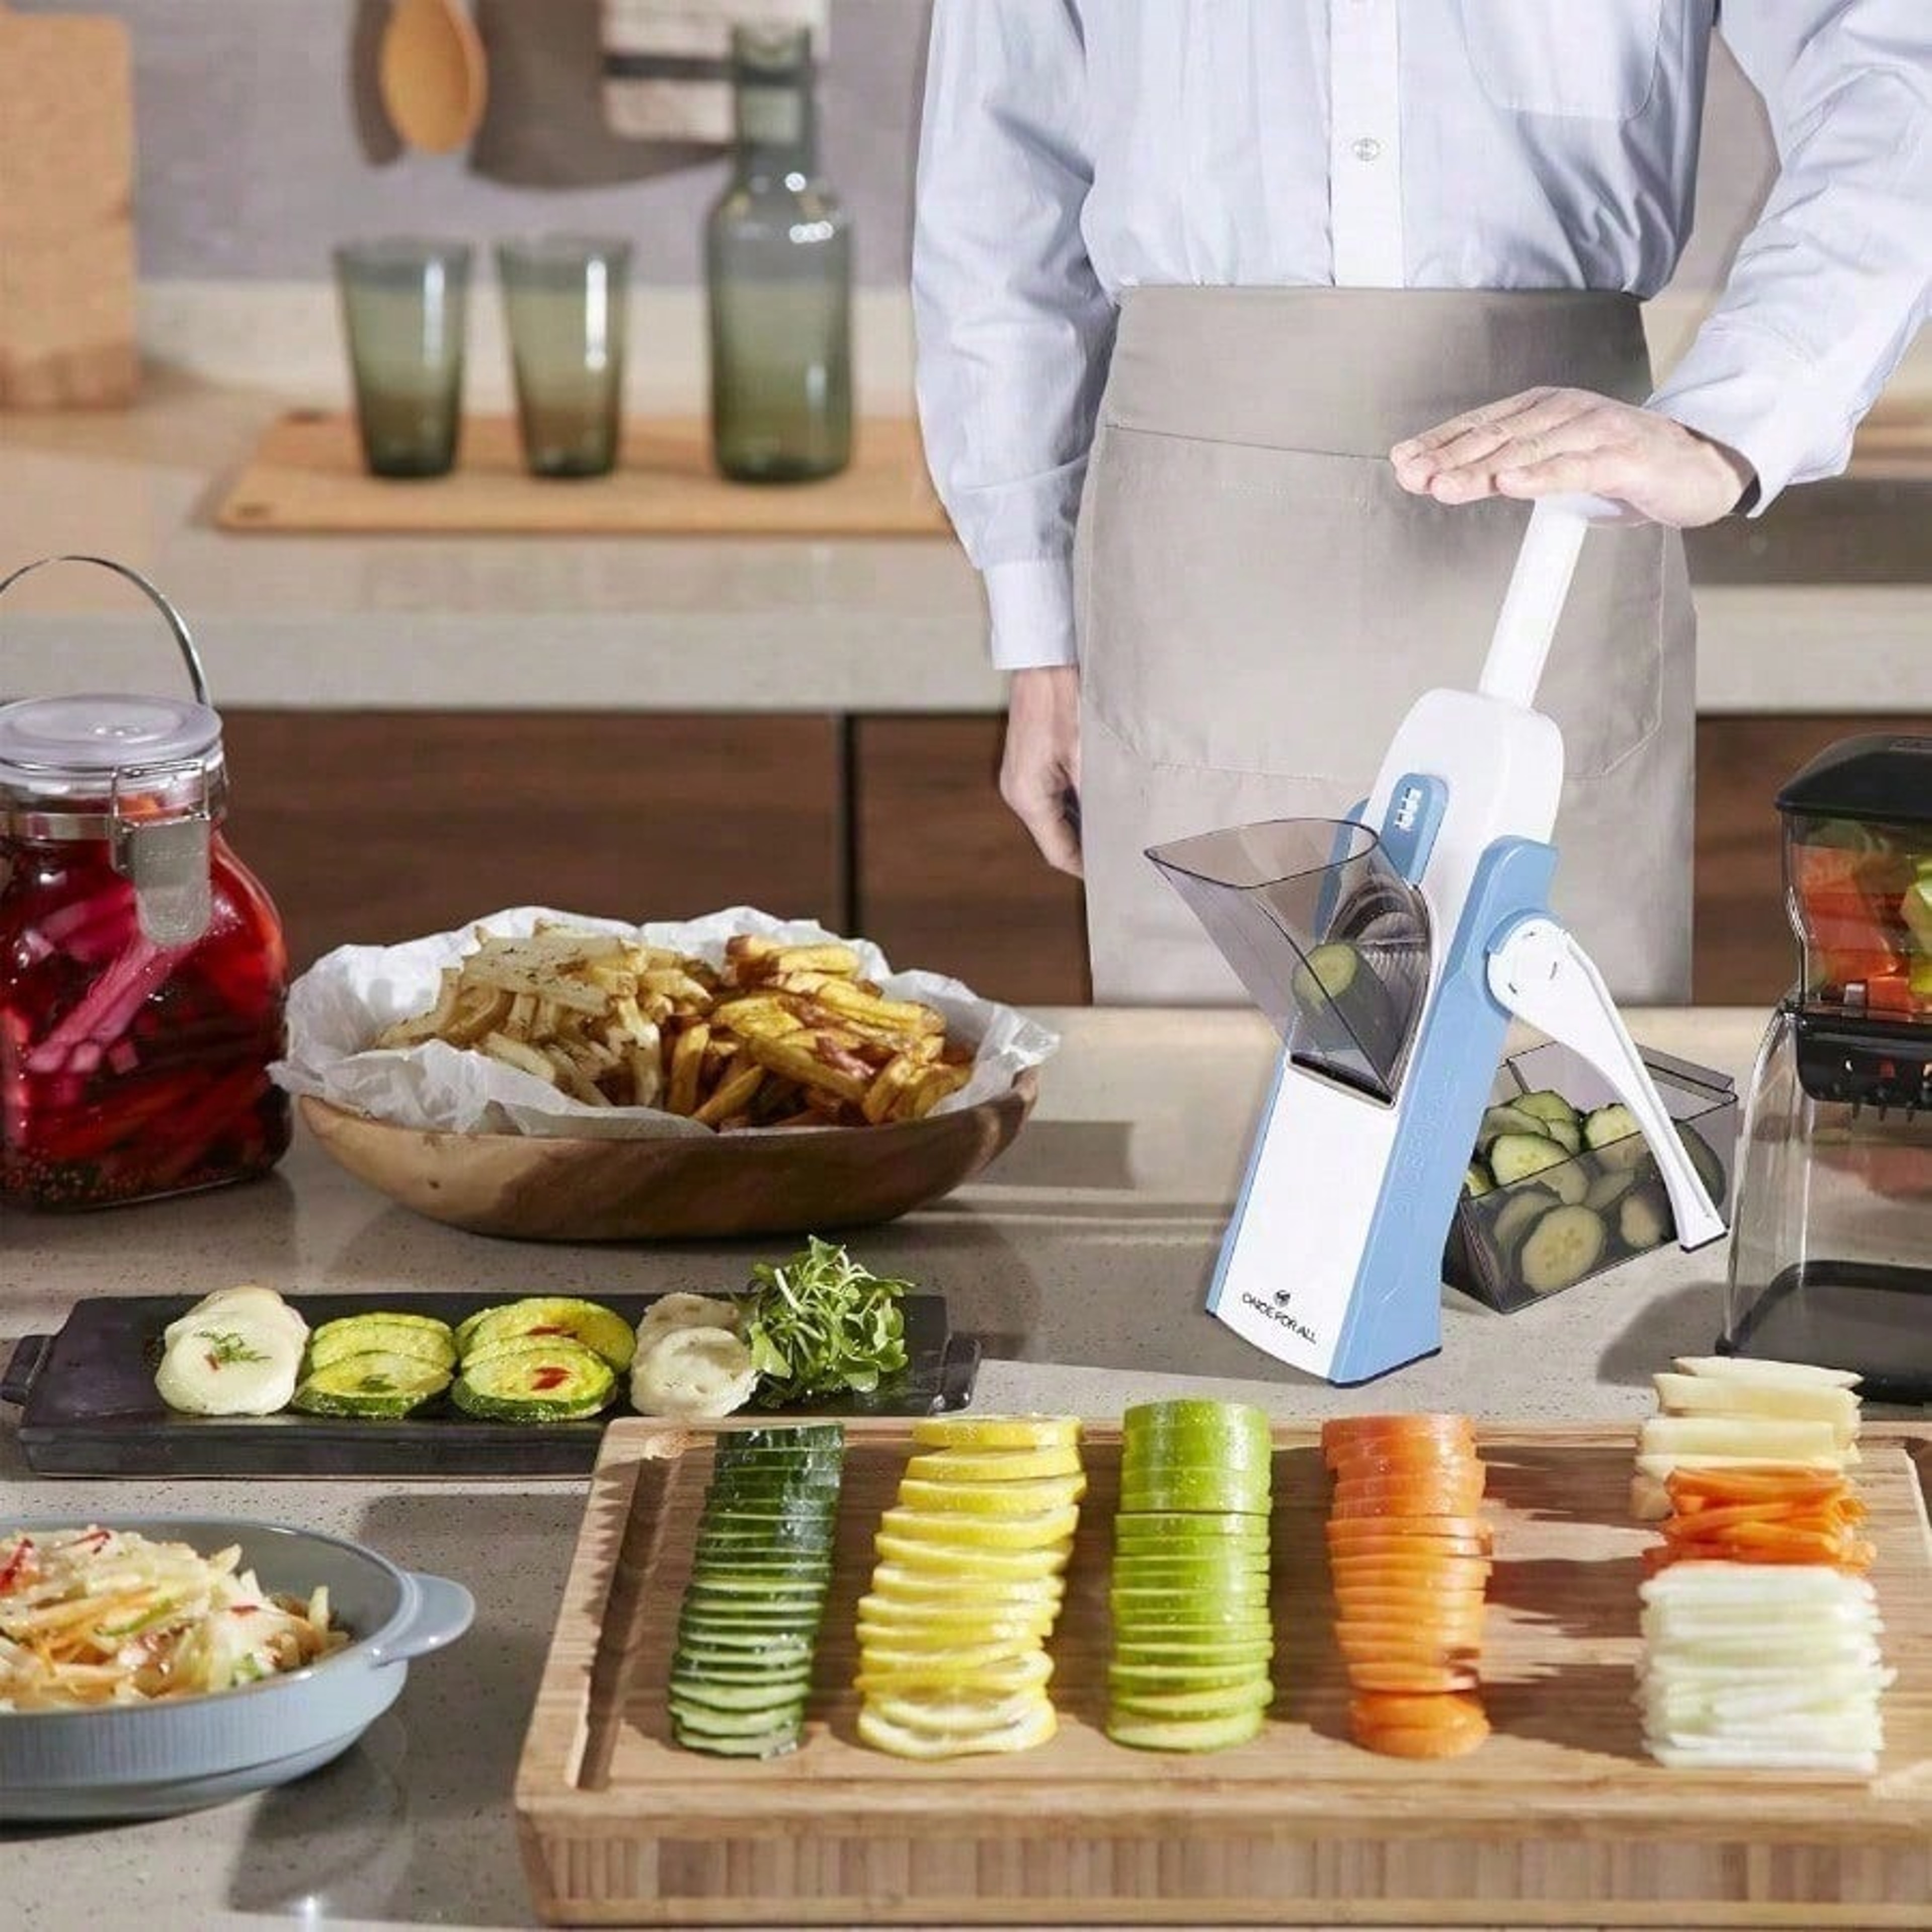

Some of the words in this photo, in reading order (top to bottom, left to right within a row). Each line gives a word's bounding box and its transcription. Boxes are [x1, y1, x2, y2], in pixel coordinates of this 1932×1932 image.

[1242, 1292, 1274, 1318] ONCE
[1274, 1311, 1297, 1331] FOR
[1296, 1326, 1317, 1344] ALL
